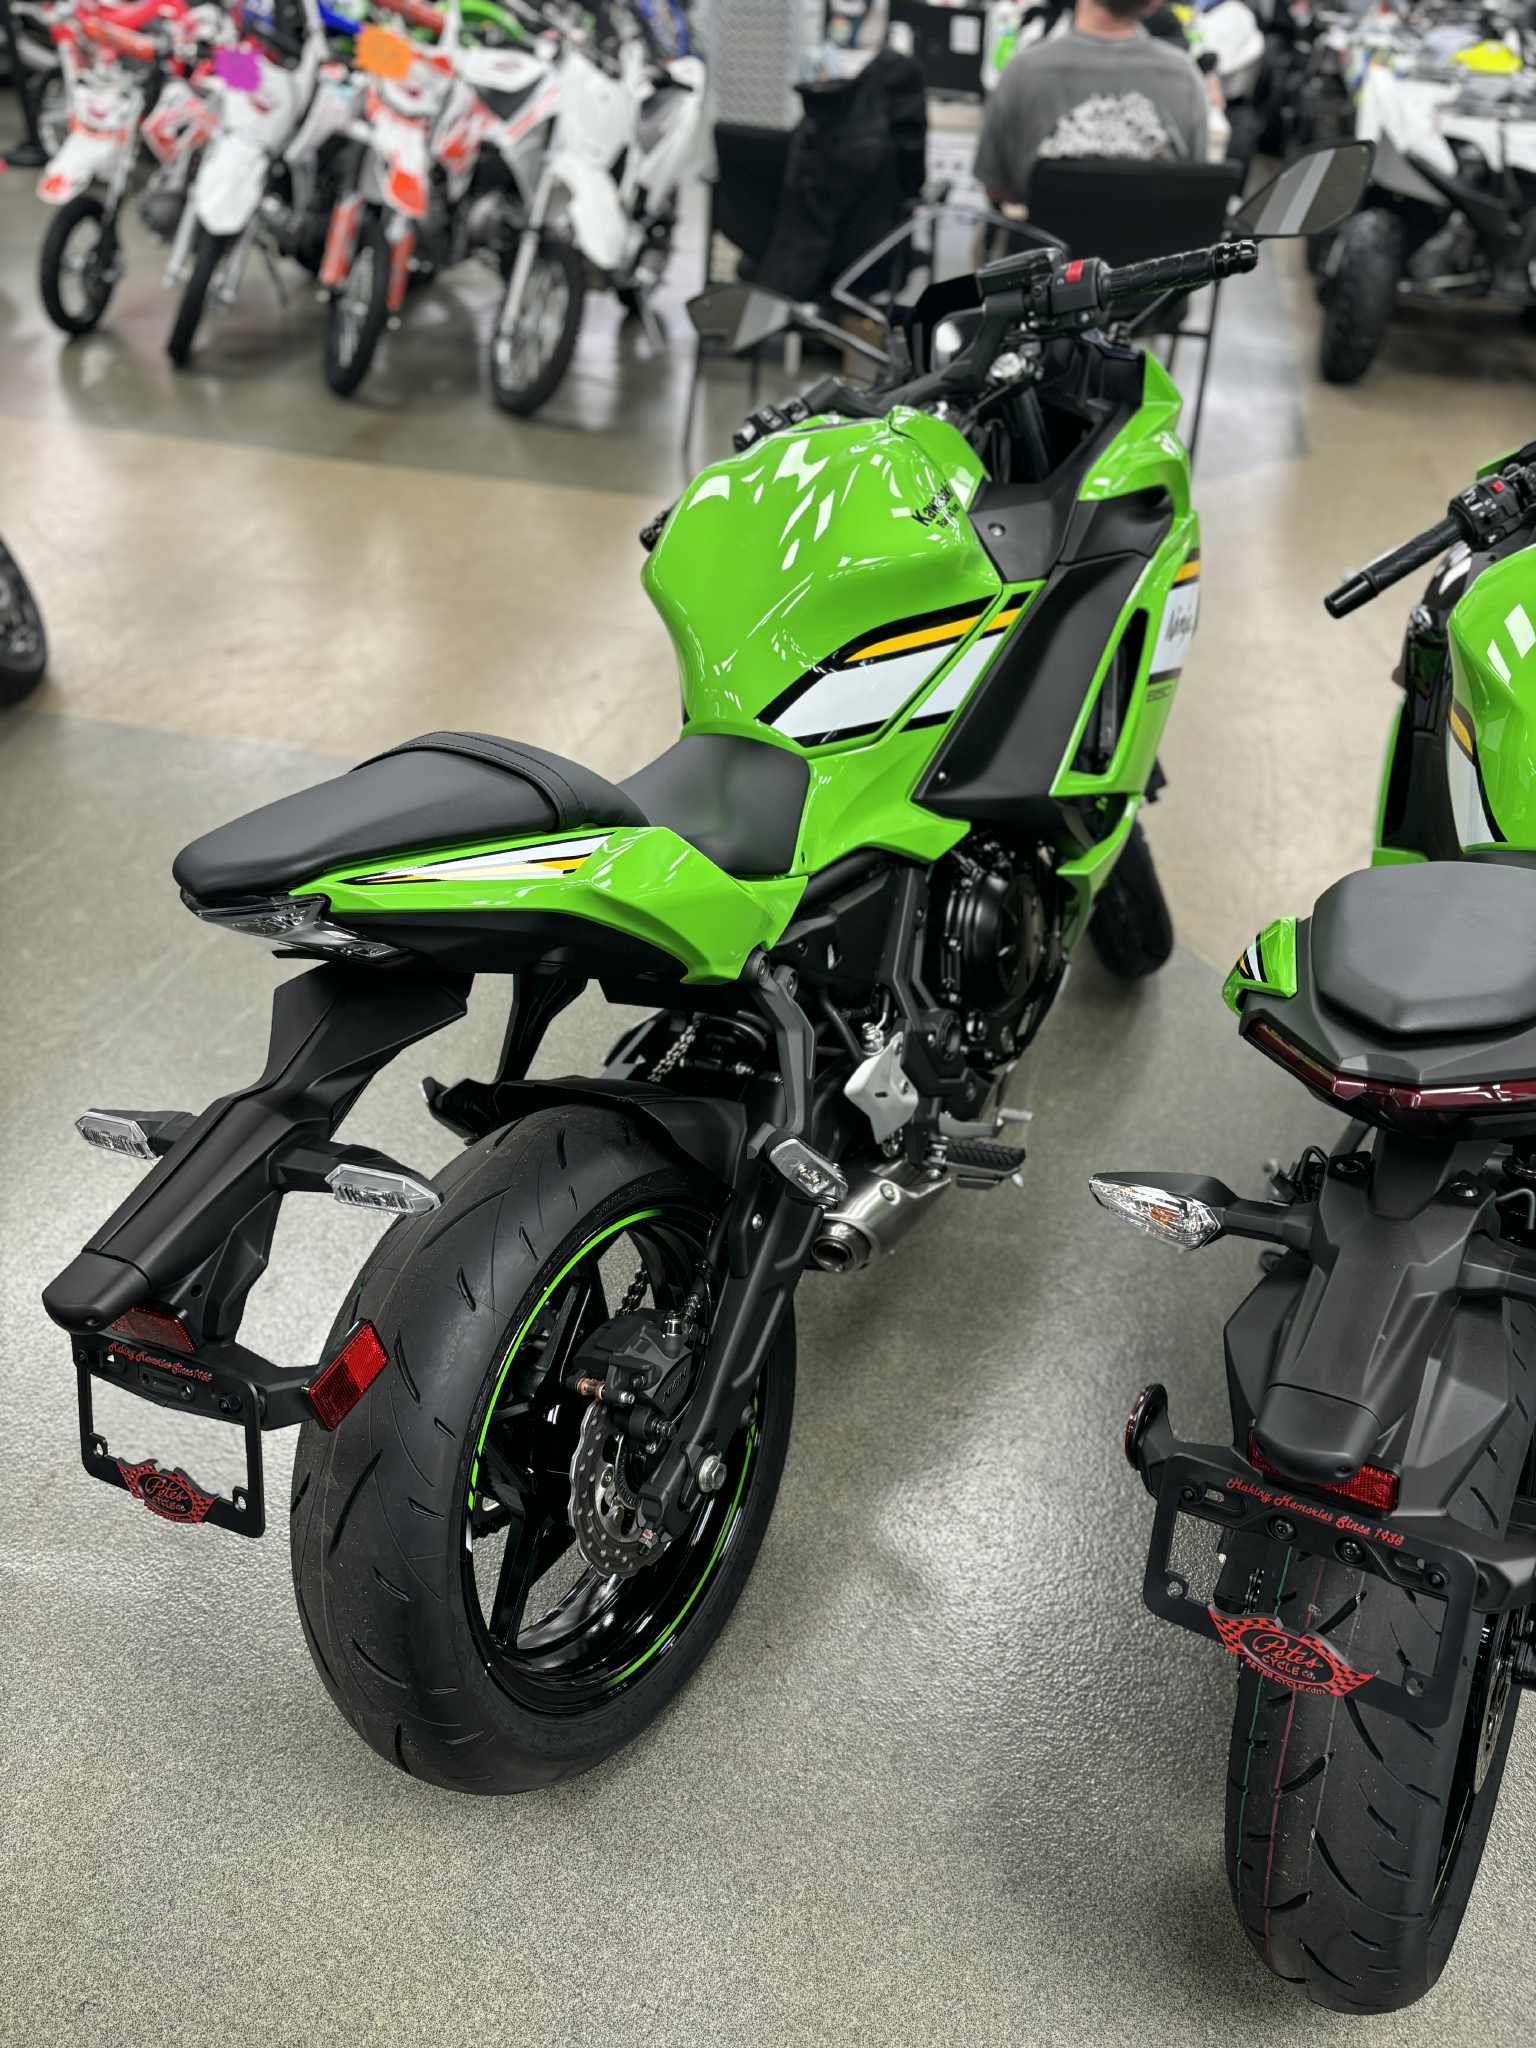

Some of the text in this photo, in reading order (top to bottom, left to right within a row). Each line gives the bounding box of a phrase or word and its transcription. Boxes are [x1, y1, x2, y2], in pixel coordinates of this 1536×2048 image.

[1226, 1477, 1406, 1546] Making Memories Since 1938
[1252, 1633, 1324, 1669] Pete's
[1261, 1654, 1300, 1676] CYCLE
